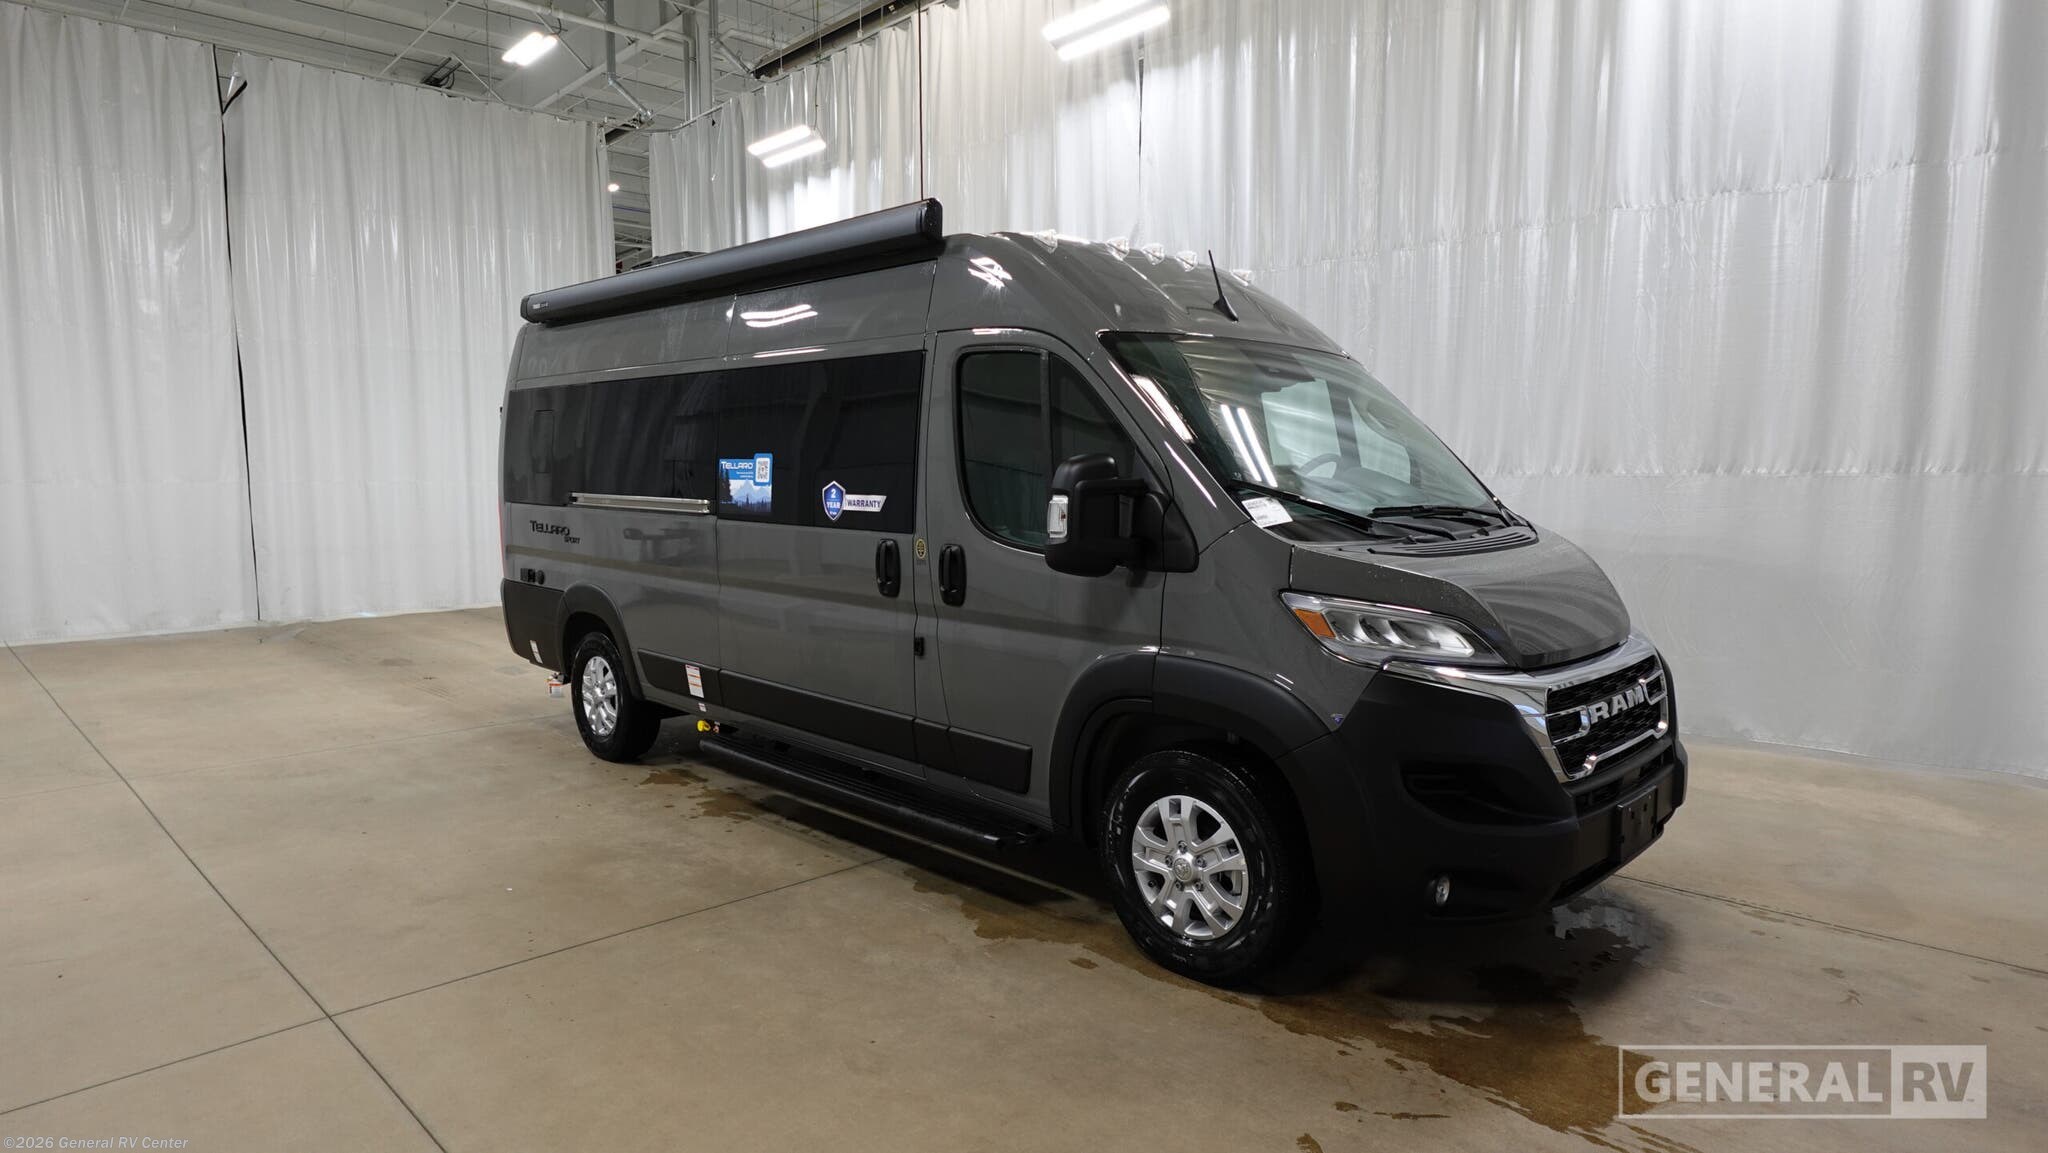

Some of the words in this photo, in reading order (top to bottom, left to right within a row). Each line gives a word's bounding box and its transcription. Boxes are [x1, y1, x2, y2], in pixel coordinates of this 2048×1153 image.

[720, 461, 754, 470] TELLARO
[830, 488, 837, 499] 2
[847, 499, 881, 508] WARRANTY
[529, 520, 570, 536] TELLARO
[1587, 685, 1645, 725] RAM
